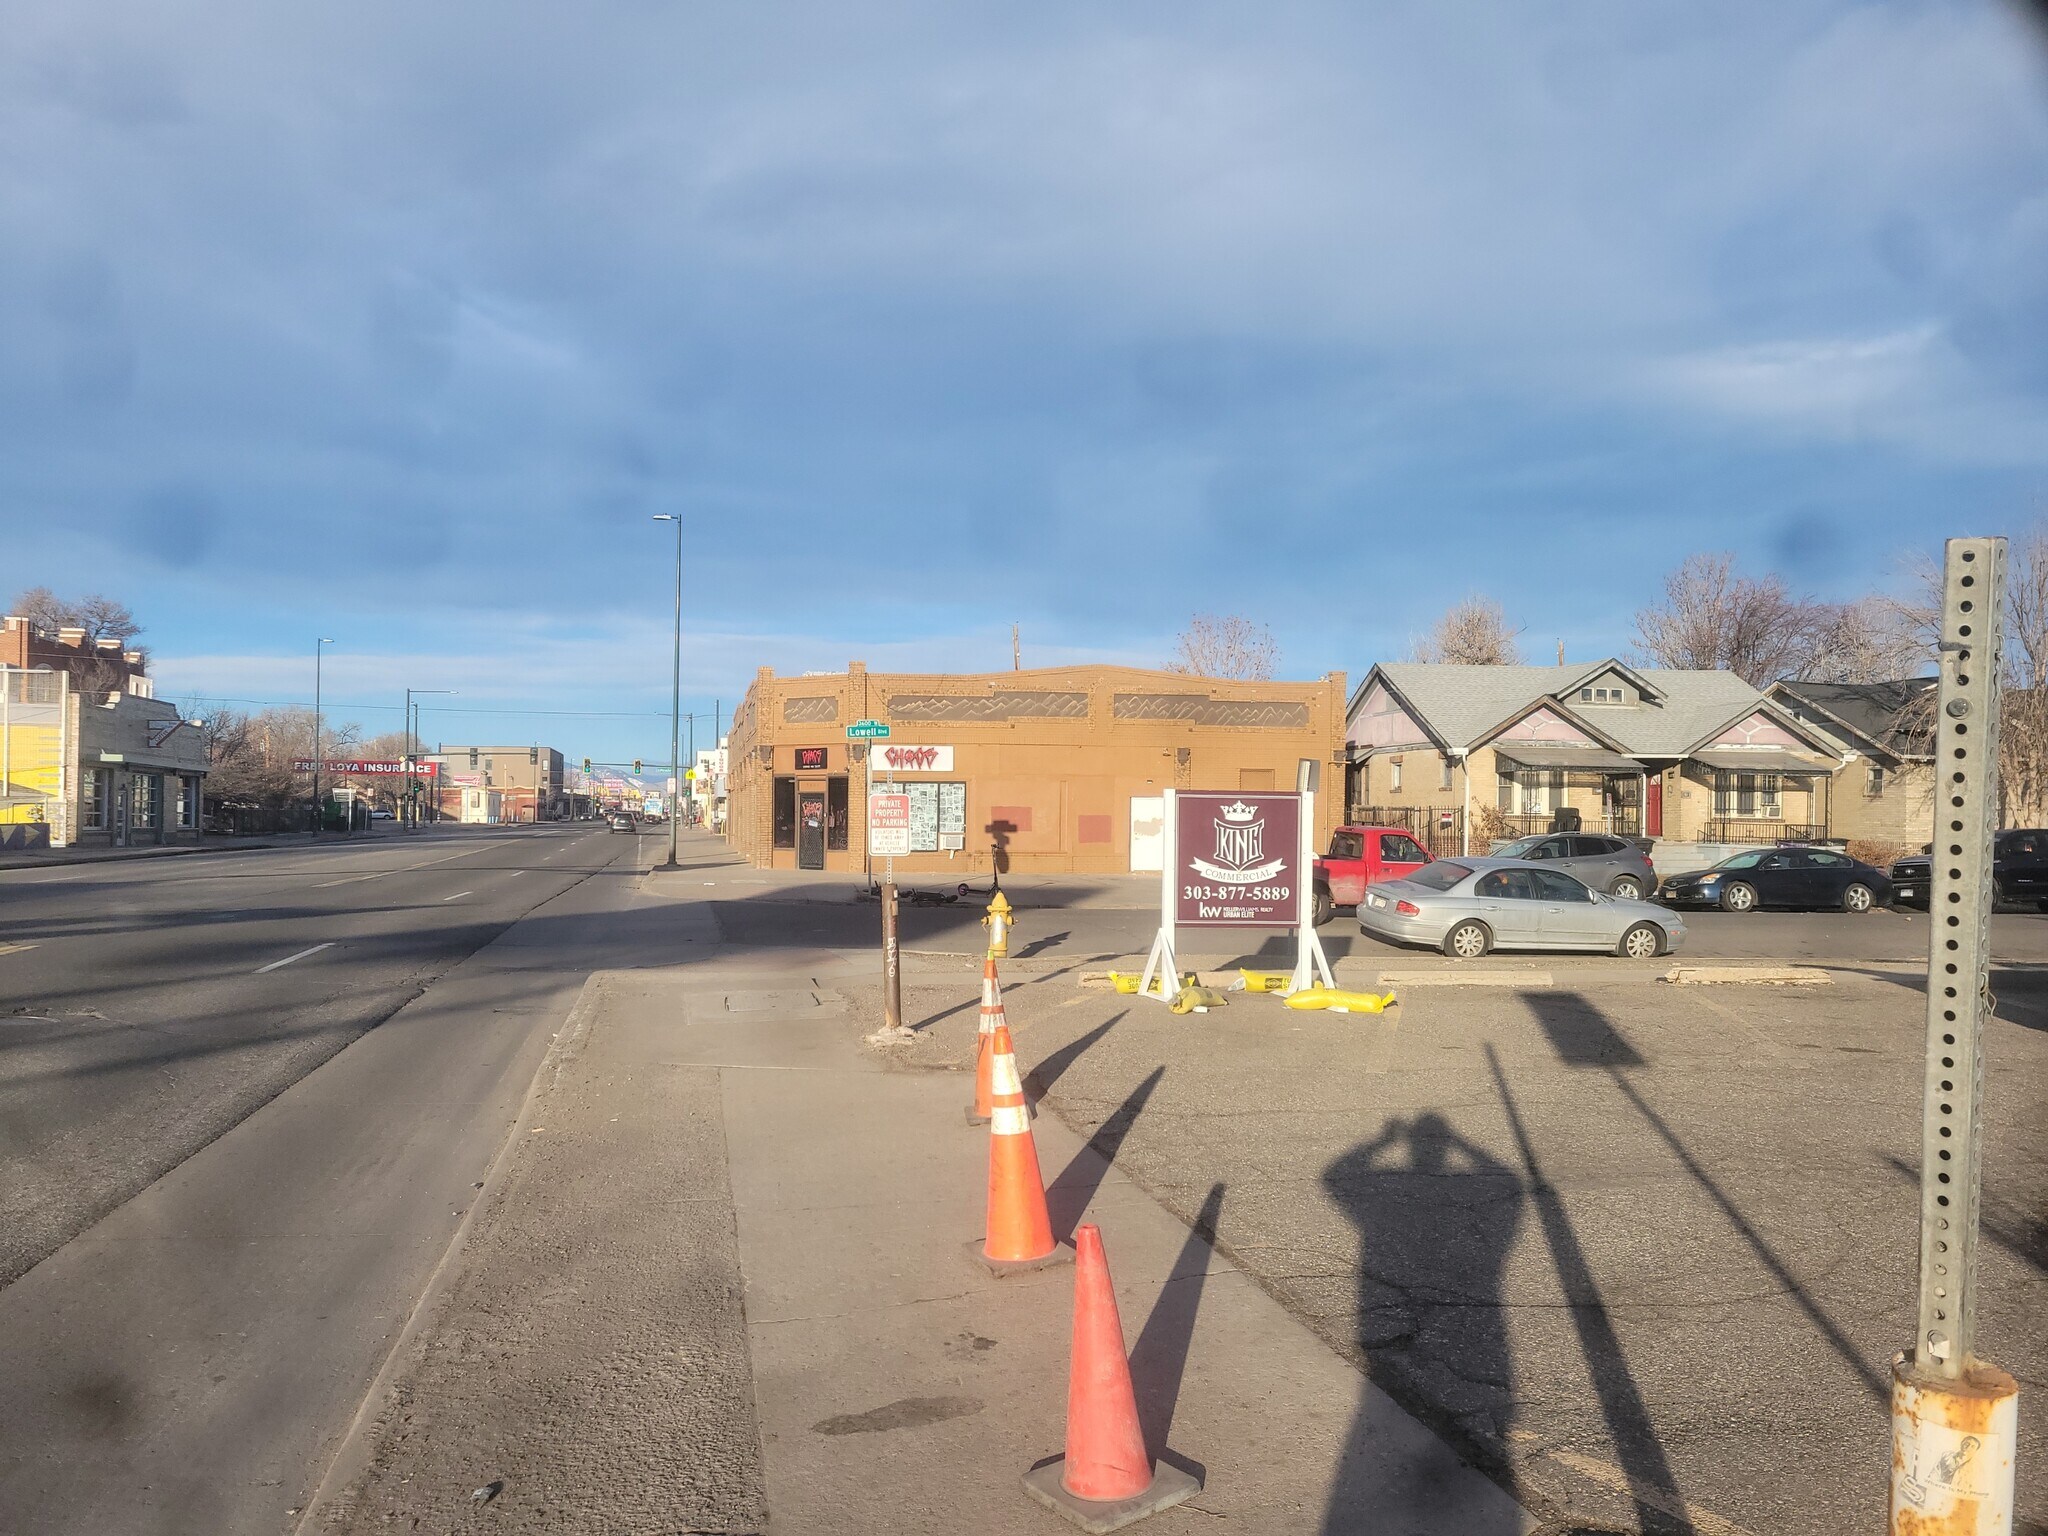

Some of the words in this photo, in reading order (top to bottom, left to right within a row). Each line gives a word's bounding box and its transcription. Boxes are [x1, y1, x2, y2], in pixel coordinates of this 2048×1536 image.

[849, 728, 877, 736] Lowell
[294, 762, 325, 771] FRED
[330, 762, 359, 772] LOYA
[364, 763, 432, 773] INSURCE
[878, 800, 902, 808] PRIVATE
[875, 809, 904, 817] PROPERTY
[872, 818, 880, 827] NO
[882, 818, 908, 827] PARKING
[1219, 826, 1260, 866] KING
[1205, 868, 1272, 882] COMMERCIAL
[1183, 886, 1290, 901] 303-877-5889
[1199, 902, 1222, 918] kw
